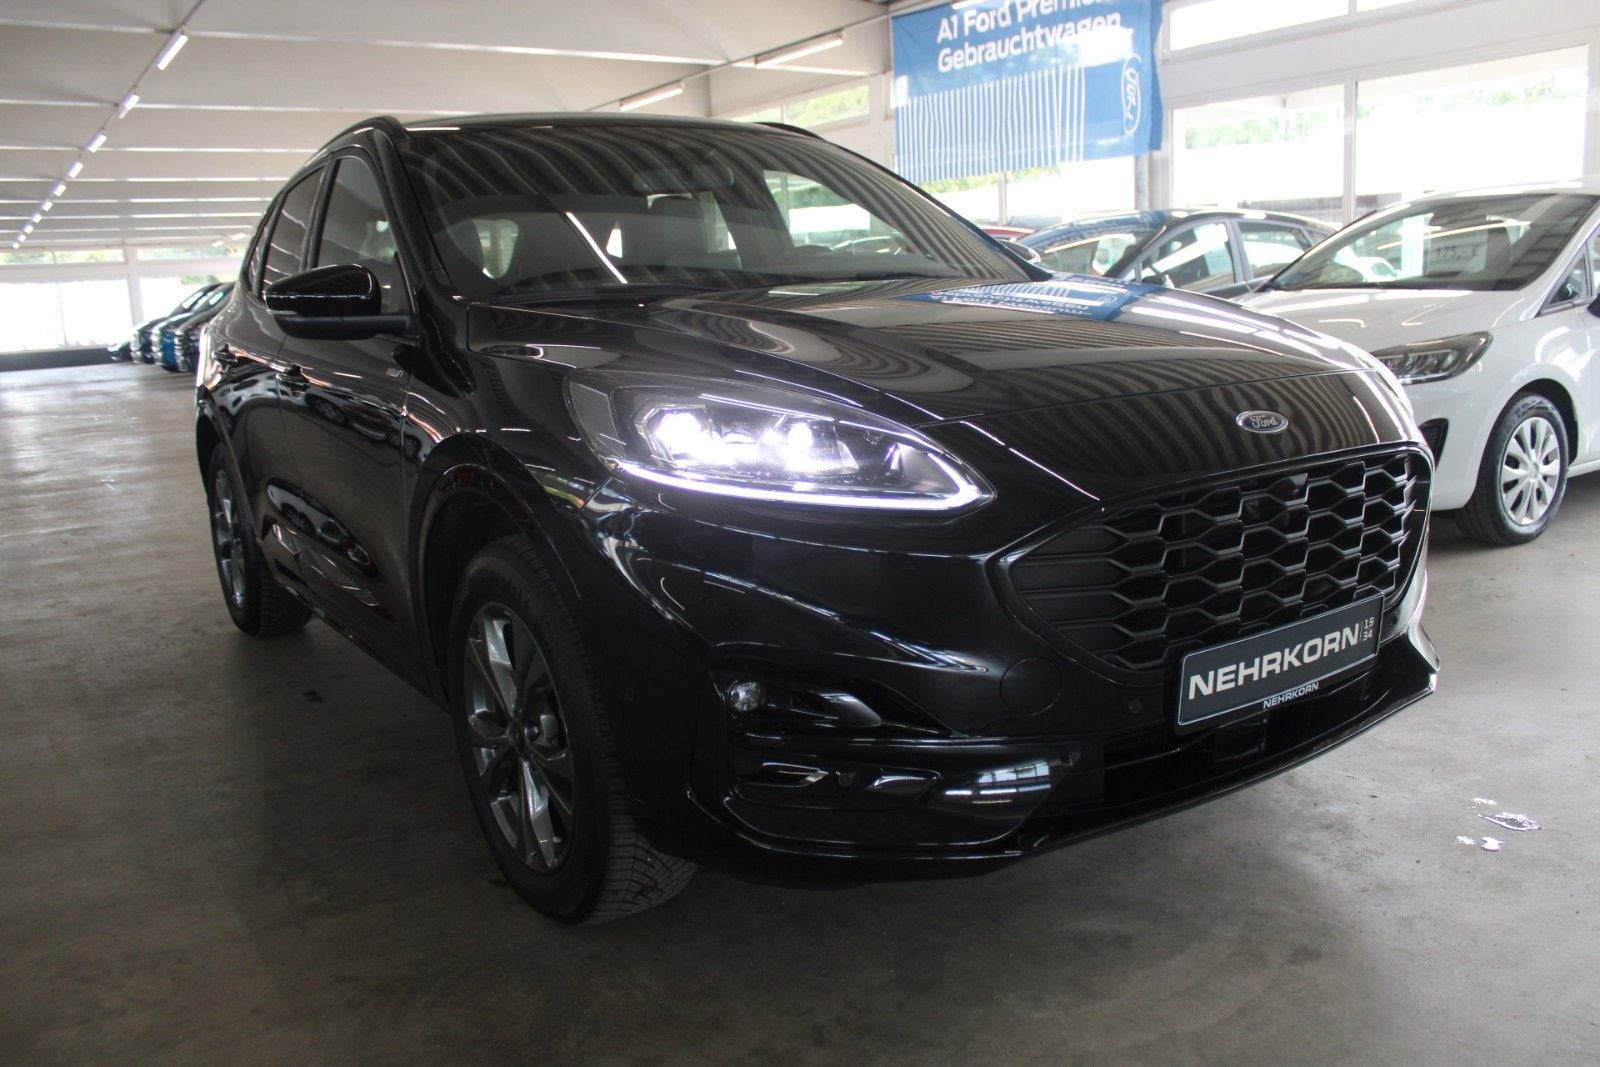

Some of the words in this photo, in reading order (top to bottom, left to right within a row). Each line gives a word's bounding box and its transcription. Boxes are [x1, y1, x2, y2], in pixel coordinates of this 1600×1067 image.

[937, 15, 959, 44] A1
[963, 5, 1014, 36] Ford
[1015, 0, 1105, 23] Prem
[1250, 415, 1278, 428] Ford
[1362, 629, 1373, 642] 34
[1188, 622, 1360, 700] NEHRKORN
[1364, 617, 1375, 629] 19
[1263, 681, 1320, 709] NEHRKORN
